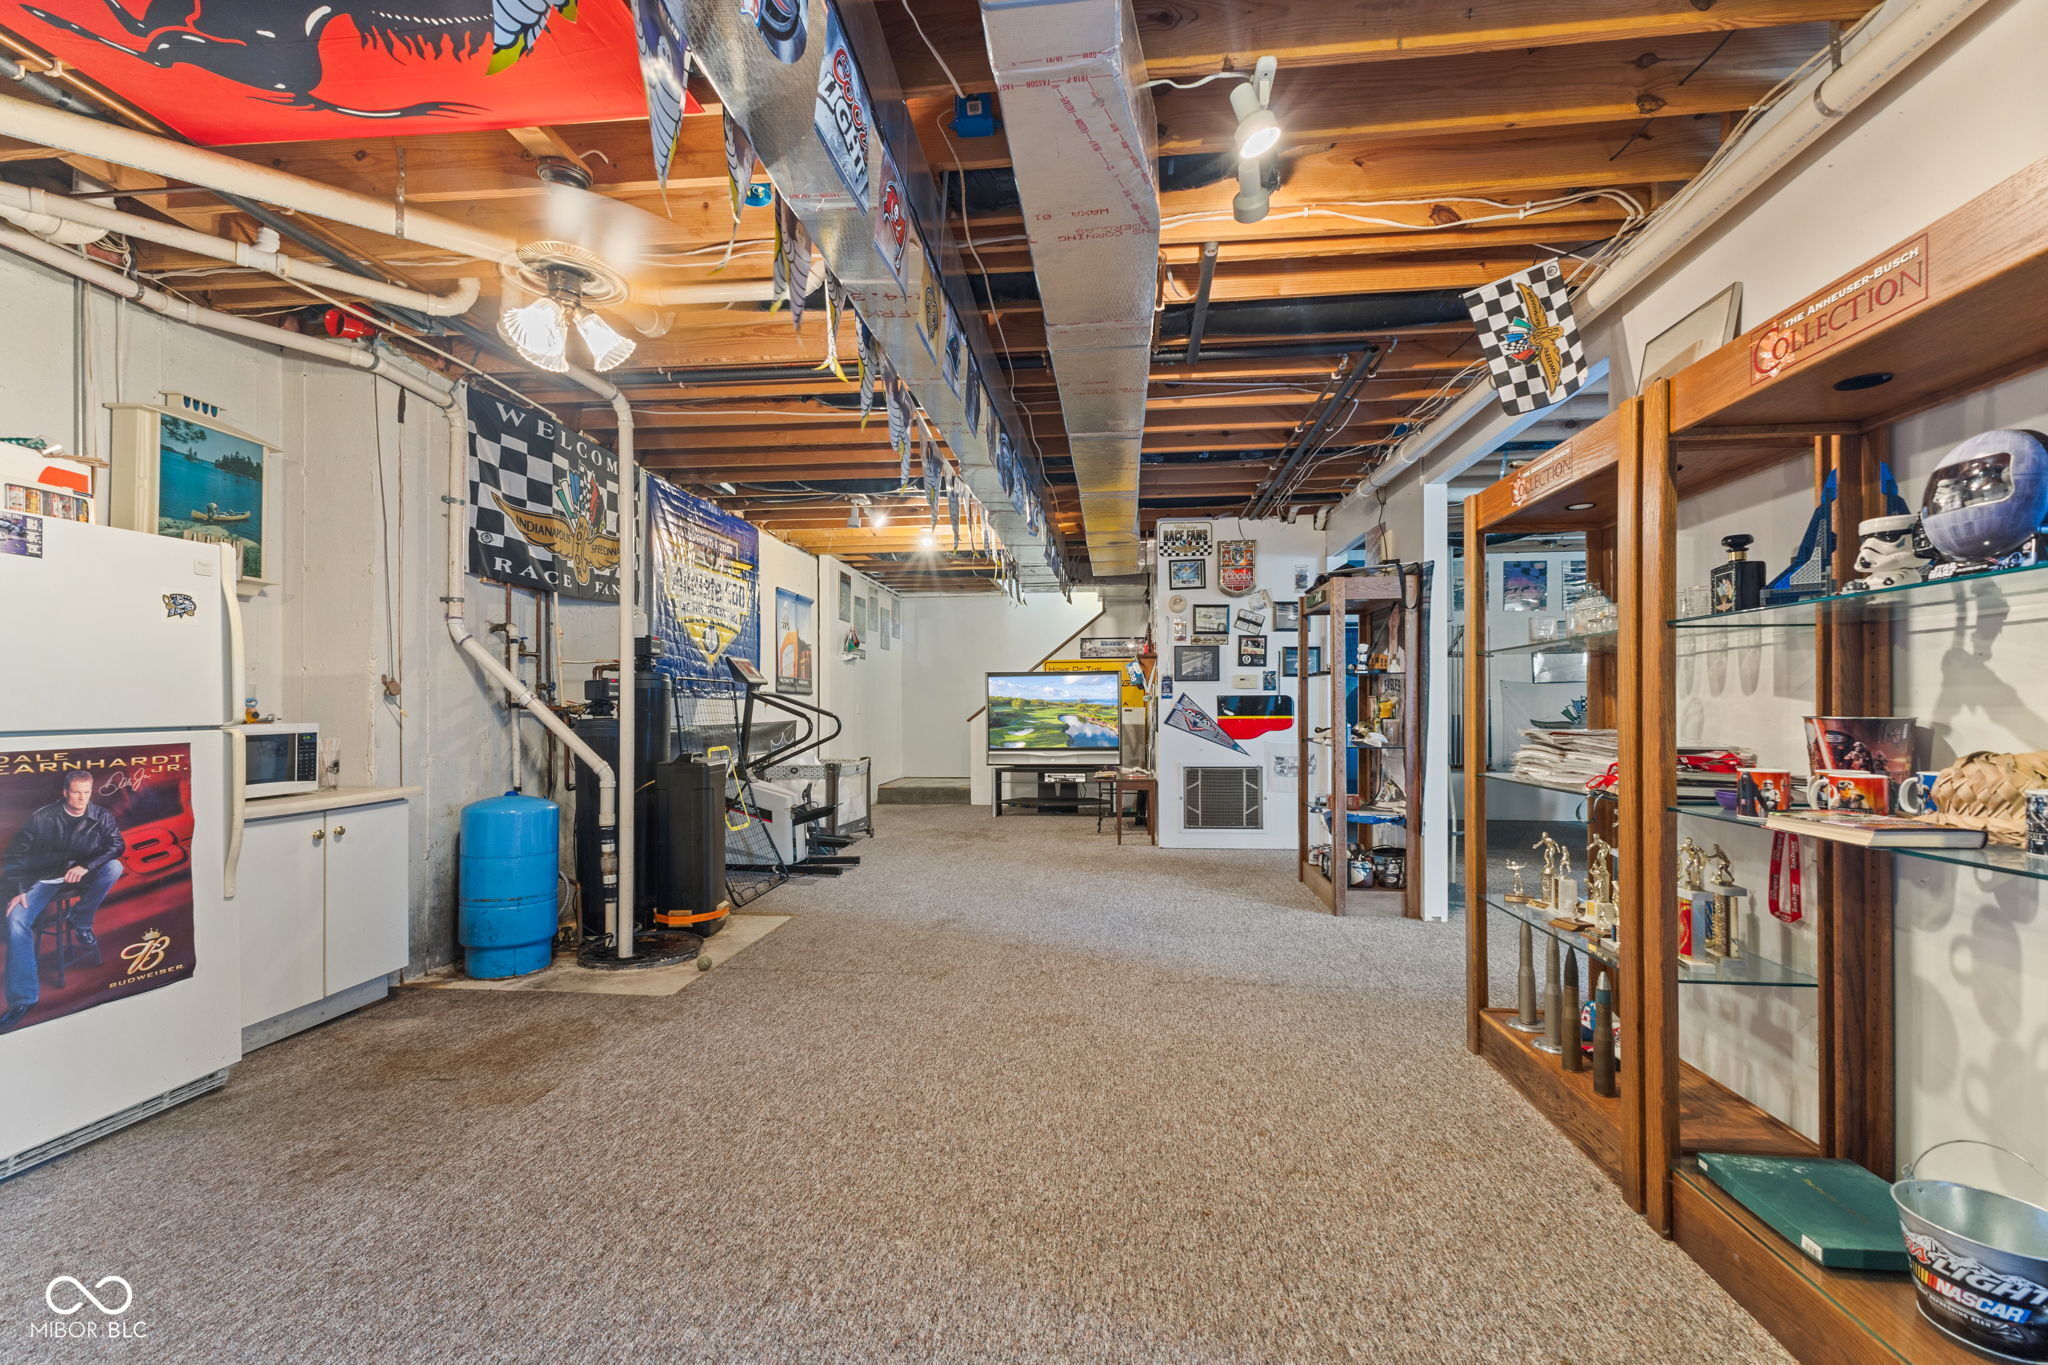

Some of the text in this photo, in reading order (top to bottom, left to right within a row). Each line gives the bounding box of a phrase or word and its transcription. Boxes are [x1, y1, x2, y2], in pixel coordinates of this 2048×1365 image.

[817, 73, 866, 182] LIGHT
[1784, 246, 1920, 329] THE ANHEUSER-BUSCH
[1752, 260, 1923, 375] COLLECTION
[496, 401, 619, 476] WELCOM
[515, 514, 571, 545] INDIANAPOLIS
[574, 524, 585, 578] MOTOR
[493, 556, 621, 596] RACE FAN
[151, 764, 190, 773] JR.
[1935, 1277, 2026, 1323] NASCAR
[1970, 1315, 1992, 1329] BEER
